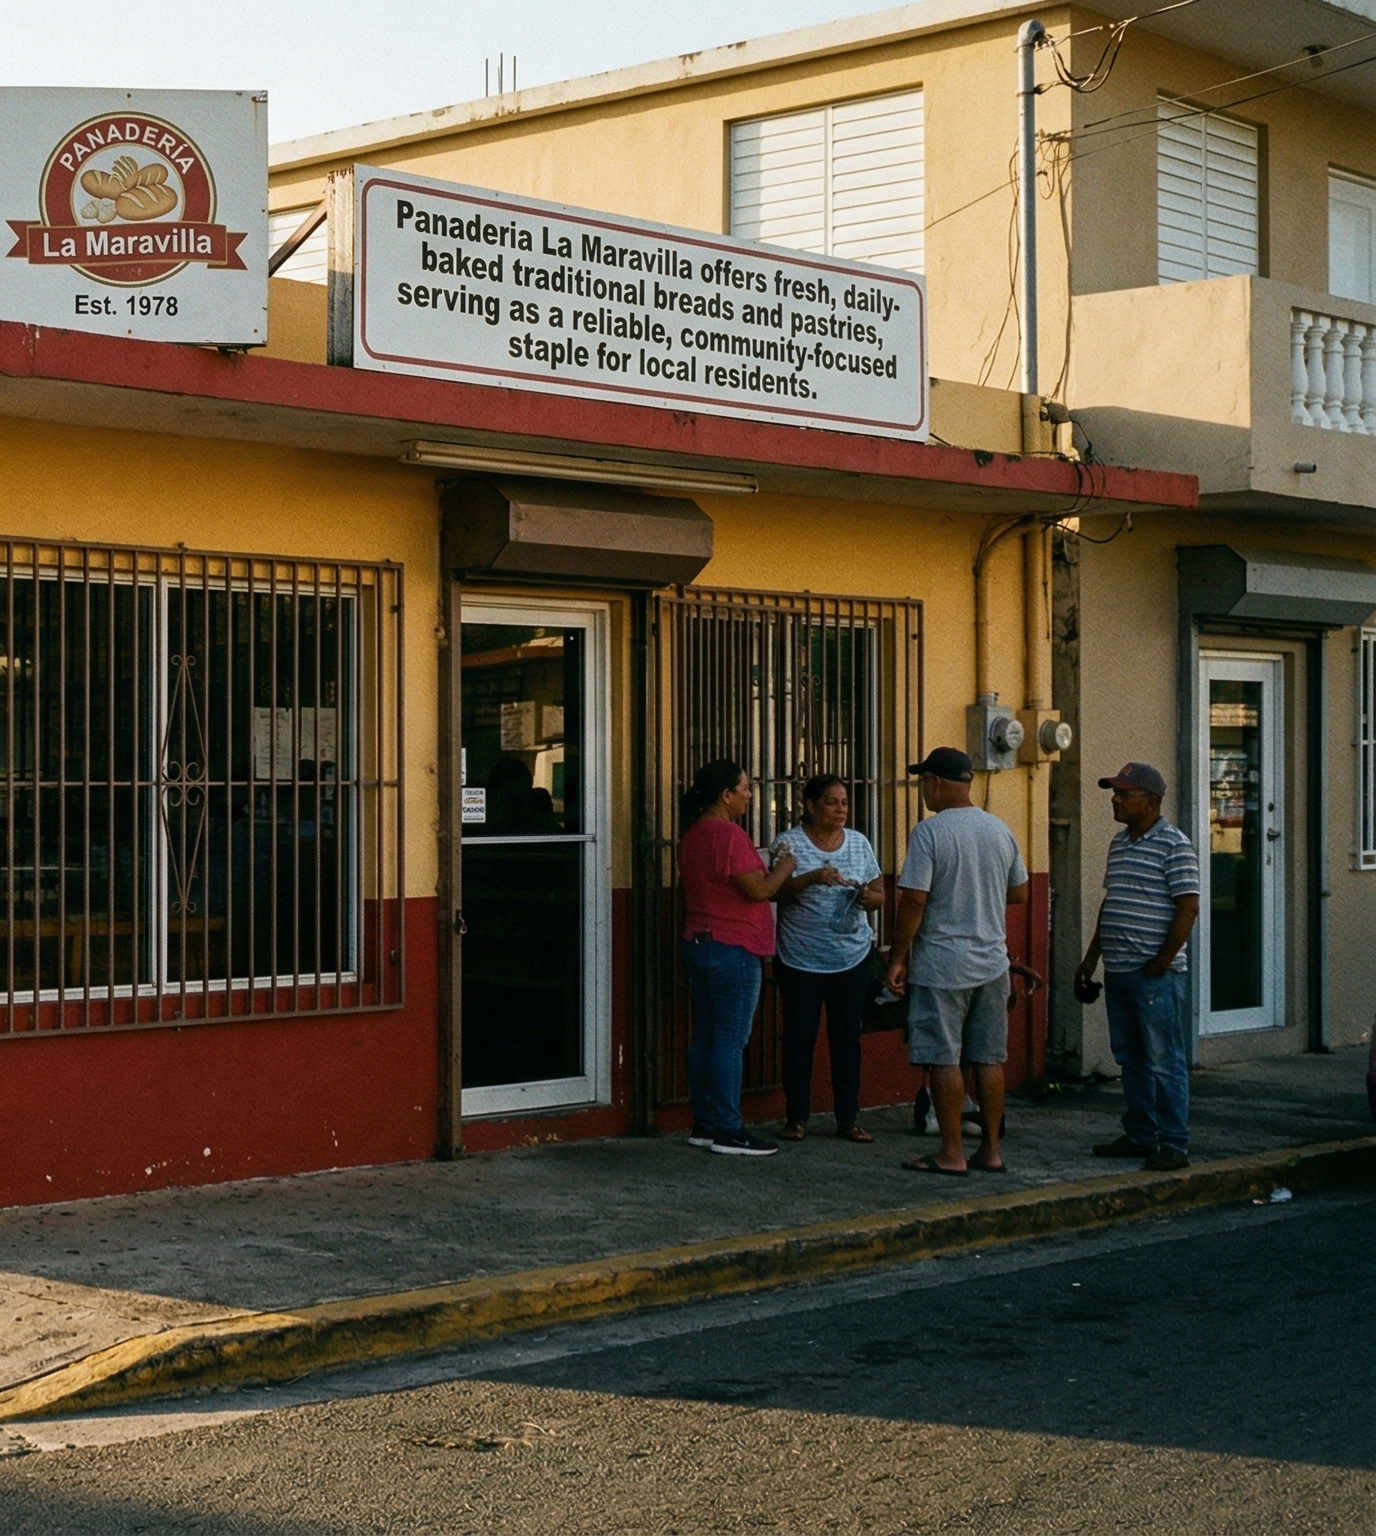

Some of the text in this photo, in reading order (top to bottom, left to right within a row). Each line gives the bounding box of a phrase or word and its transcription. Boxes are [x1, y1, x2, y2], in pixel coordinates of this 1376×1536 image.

[58, 122, 195, 174] PANADERÍA
[42, 228, 213, 258] La Maravilla
[396, 199, 901, 323] Panaderia La Maravilla offers fresh, daily-
[74, 294, 180, 317] Est. 1978
[421, 240, 884, 351] baked traditional breads and pastries,
[396, 282, 898, 380] serving as a reliable, community-focused
[507, 331, 818, 401] staple for local residents.
